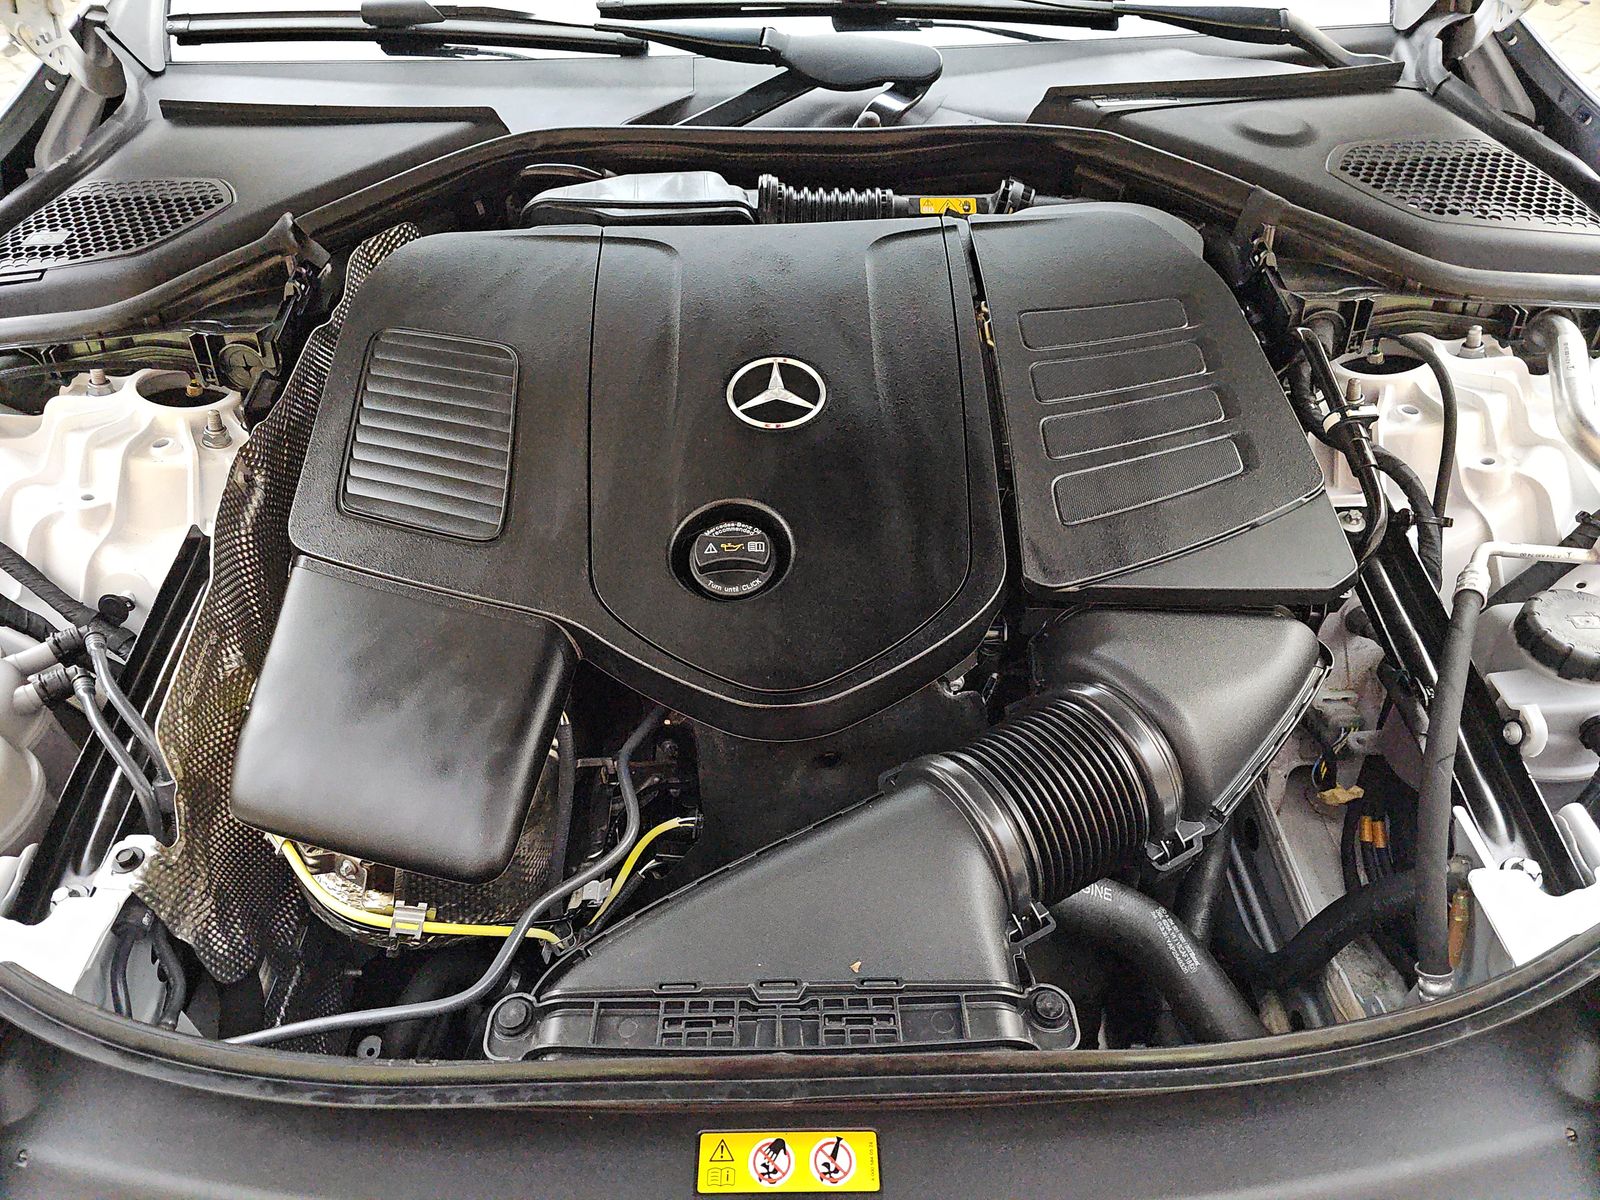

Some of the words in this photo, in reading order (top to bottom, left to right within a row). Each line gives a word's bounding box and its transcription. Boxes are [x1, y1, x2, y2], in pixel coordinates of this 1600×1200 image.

[704, 521, 753, 536] Mercedes-Benz
[712, 527, 754, 537] recommended
[708, 579, 722, 591] Turn
[724, 584, 739, 593] until
[741, 577, 762, 591] CLICK
